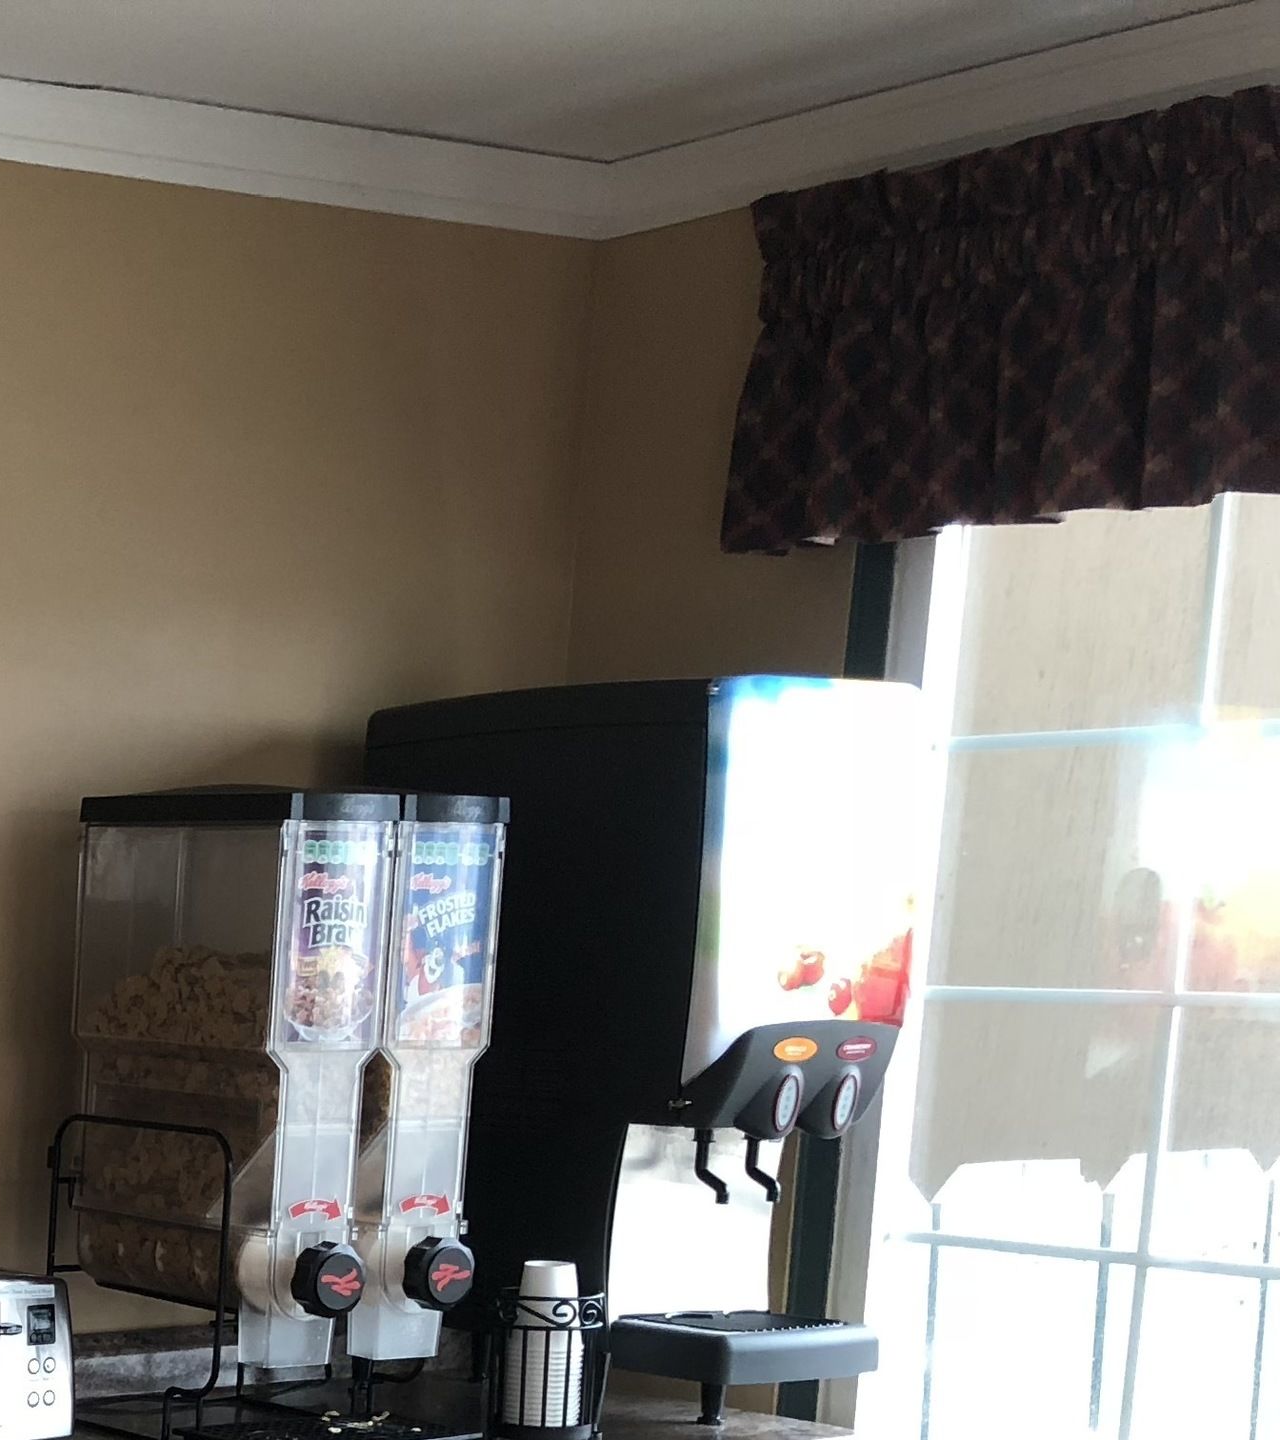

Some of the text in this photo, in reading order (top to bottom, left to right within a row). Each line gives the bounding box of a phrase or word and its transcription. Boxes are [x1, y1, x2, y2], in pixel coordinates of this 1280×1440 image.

[302, 894, 370, 928] Raisin
[418, 892, 477, 926] FROSTED
[426, 907, 476, 939] FLAKES
